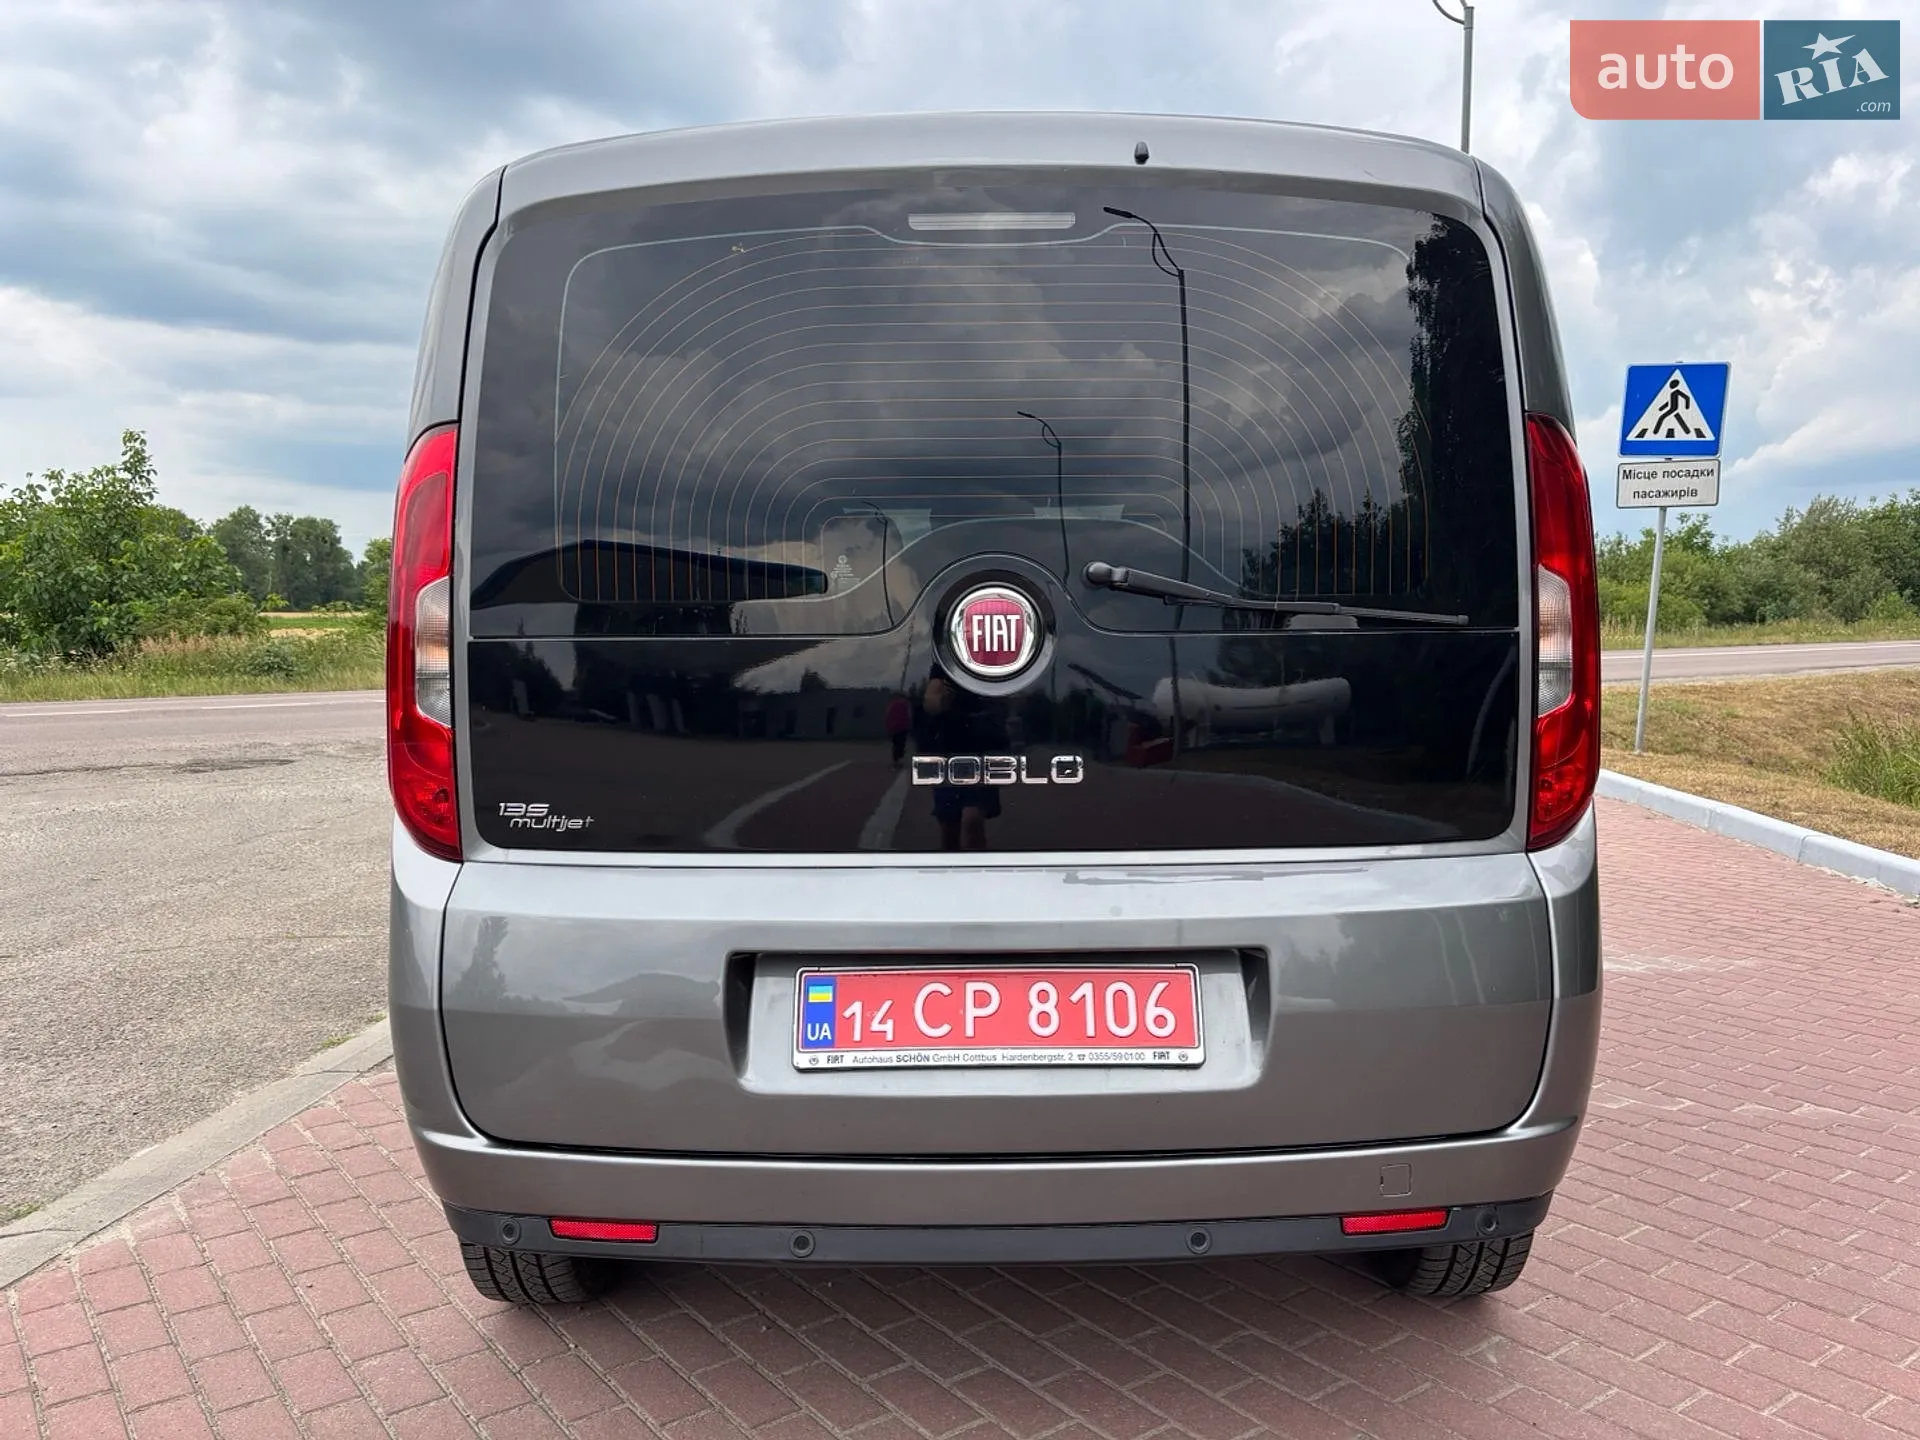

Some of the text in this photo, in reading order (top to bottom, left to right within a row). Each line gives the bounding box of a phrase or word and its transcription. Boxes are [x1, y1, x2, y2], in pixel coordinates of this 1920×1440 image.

[1622, 467, 1715, 480] Місце посадки
[1633, 486, 1698, 500] пасажирів
[971, 614, 1021, 652] FIAT
[911, 755, 1085, 785] DOBLO
[509, 815, 595, 832] multijet
[841, 980, 1178, 1042] 14 CP 8106
[807, 1023, 832, 1041] UA
[826, 1055, 845, 1065] FIAT
[852, 1054, 894, 1064] Autohaus
[895, 1053, 930, 1063] SCHÖN
[932, 1053, 960, 1063] GmbH
[963, 1052, 998, 1062] Cottbus
[1067, 1052, 1074, 1062] 2
[1153, 1051, 1171, 1061] FIAT
